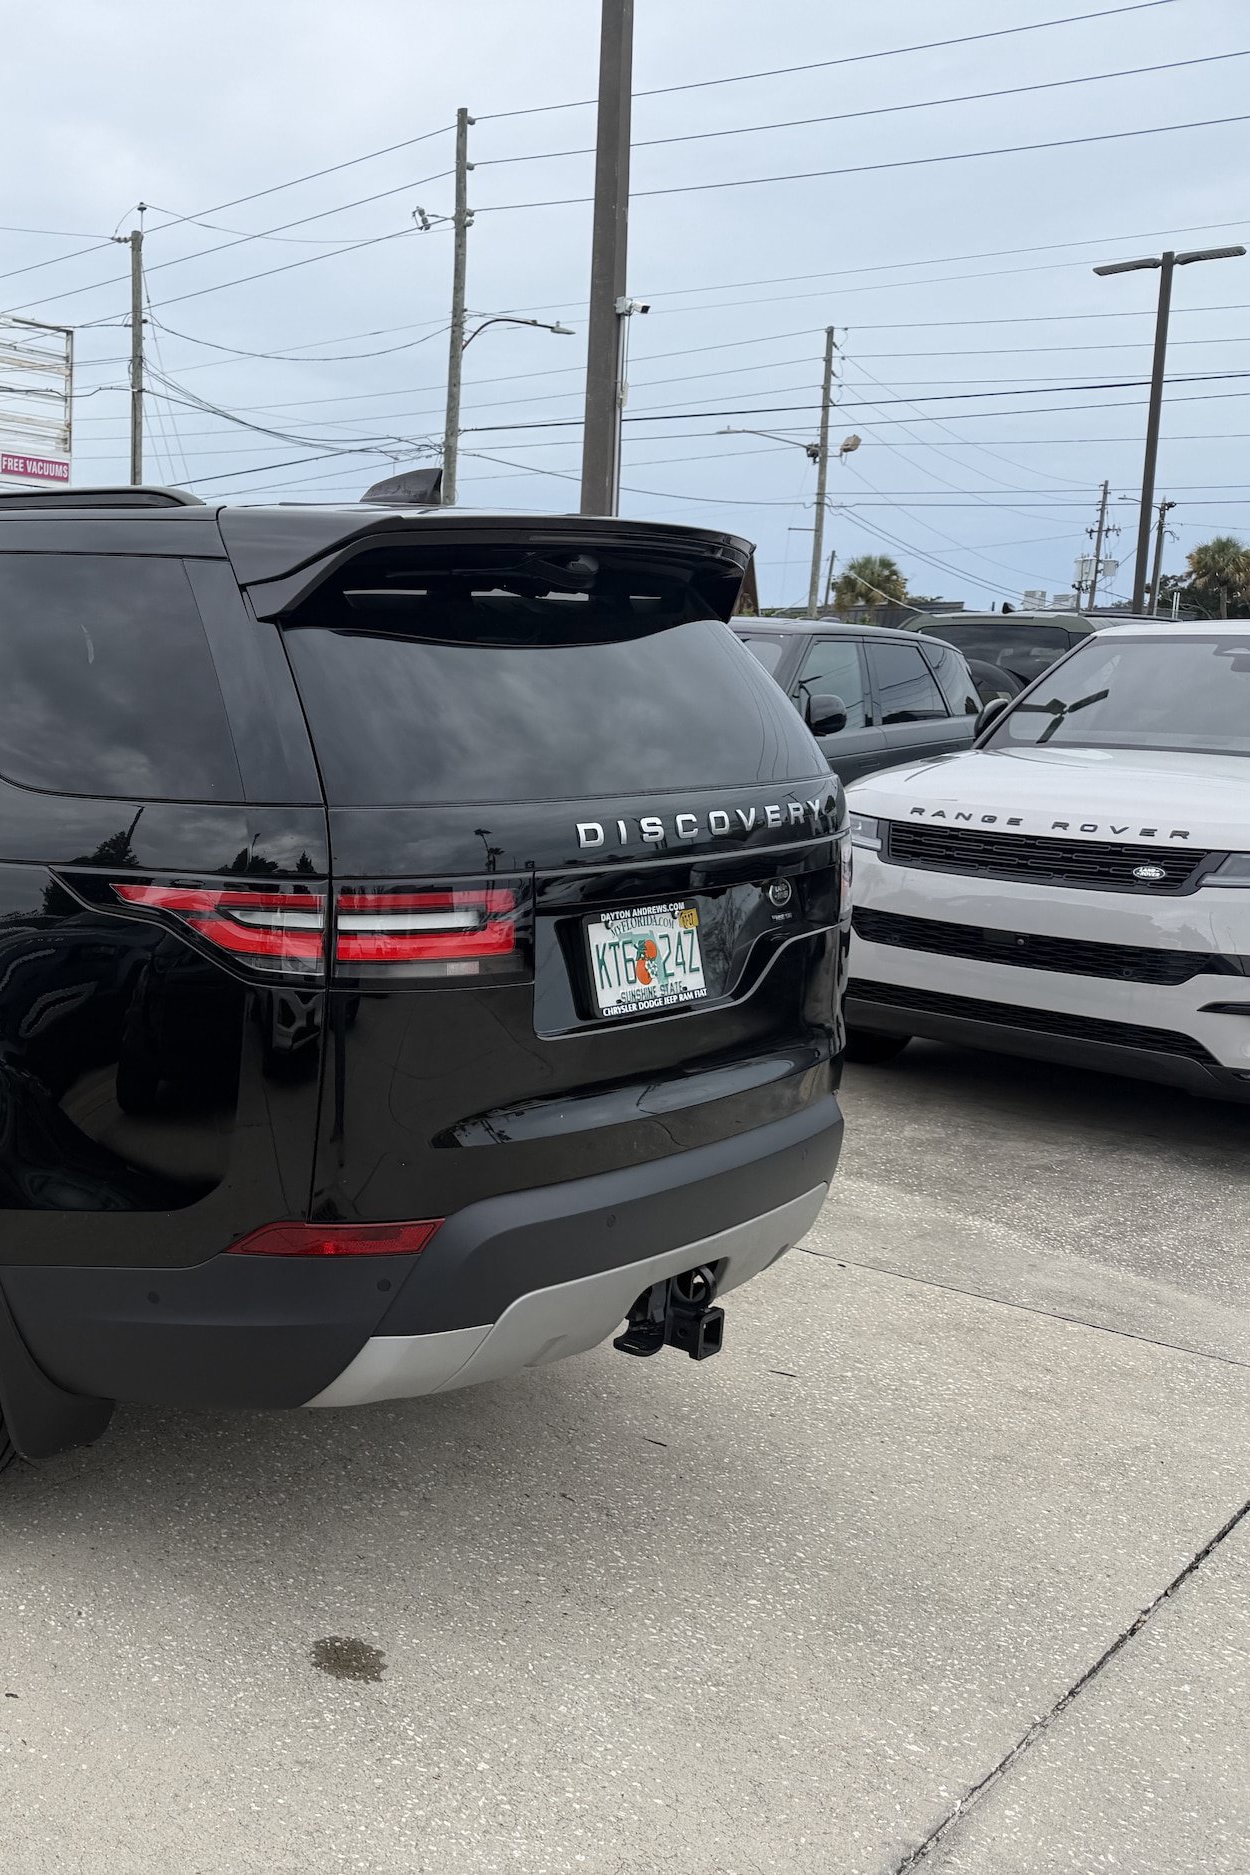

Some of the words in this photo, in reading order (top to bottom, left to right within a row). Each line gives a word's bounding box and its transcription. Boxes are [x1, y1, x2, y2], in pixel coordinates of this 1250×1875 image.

[2, 457, 24, 472] FREE
[26, 460, 68, 478] VACUUMS
[576, 799, 821, 848] DISCOVERY
[909, 806, 1023, 826] RANGE
[1051, 821, 1190, 840] ROVER
[600, 910, 631, 922] DAYTON
[632, 902, 685, 917] ANDREWS.COM
[610, 914, 675, 938] MYFLORIDA.COM
[603, 1003, 637, 1017] CHRYSLER
[639, 997, 663, 1010] DODGE
[664, 994, 678, 1005] JEEP
[679, 991, 694, 1002] RAM
[695, 988, 708, 998] FIAT
[620, 985, 657, 1004] SUNSHINE
[660, 980, 683, 996] STATE
